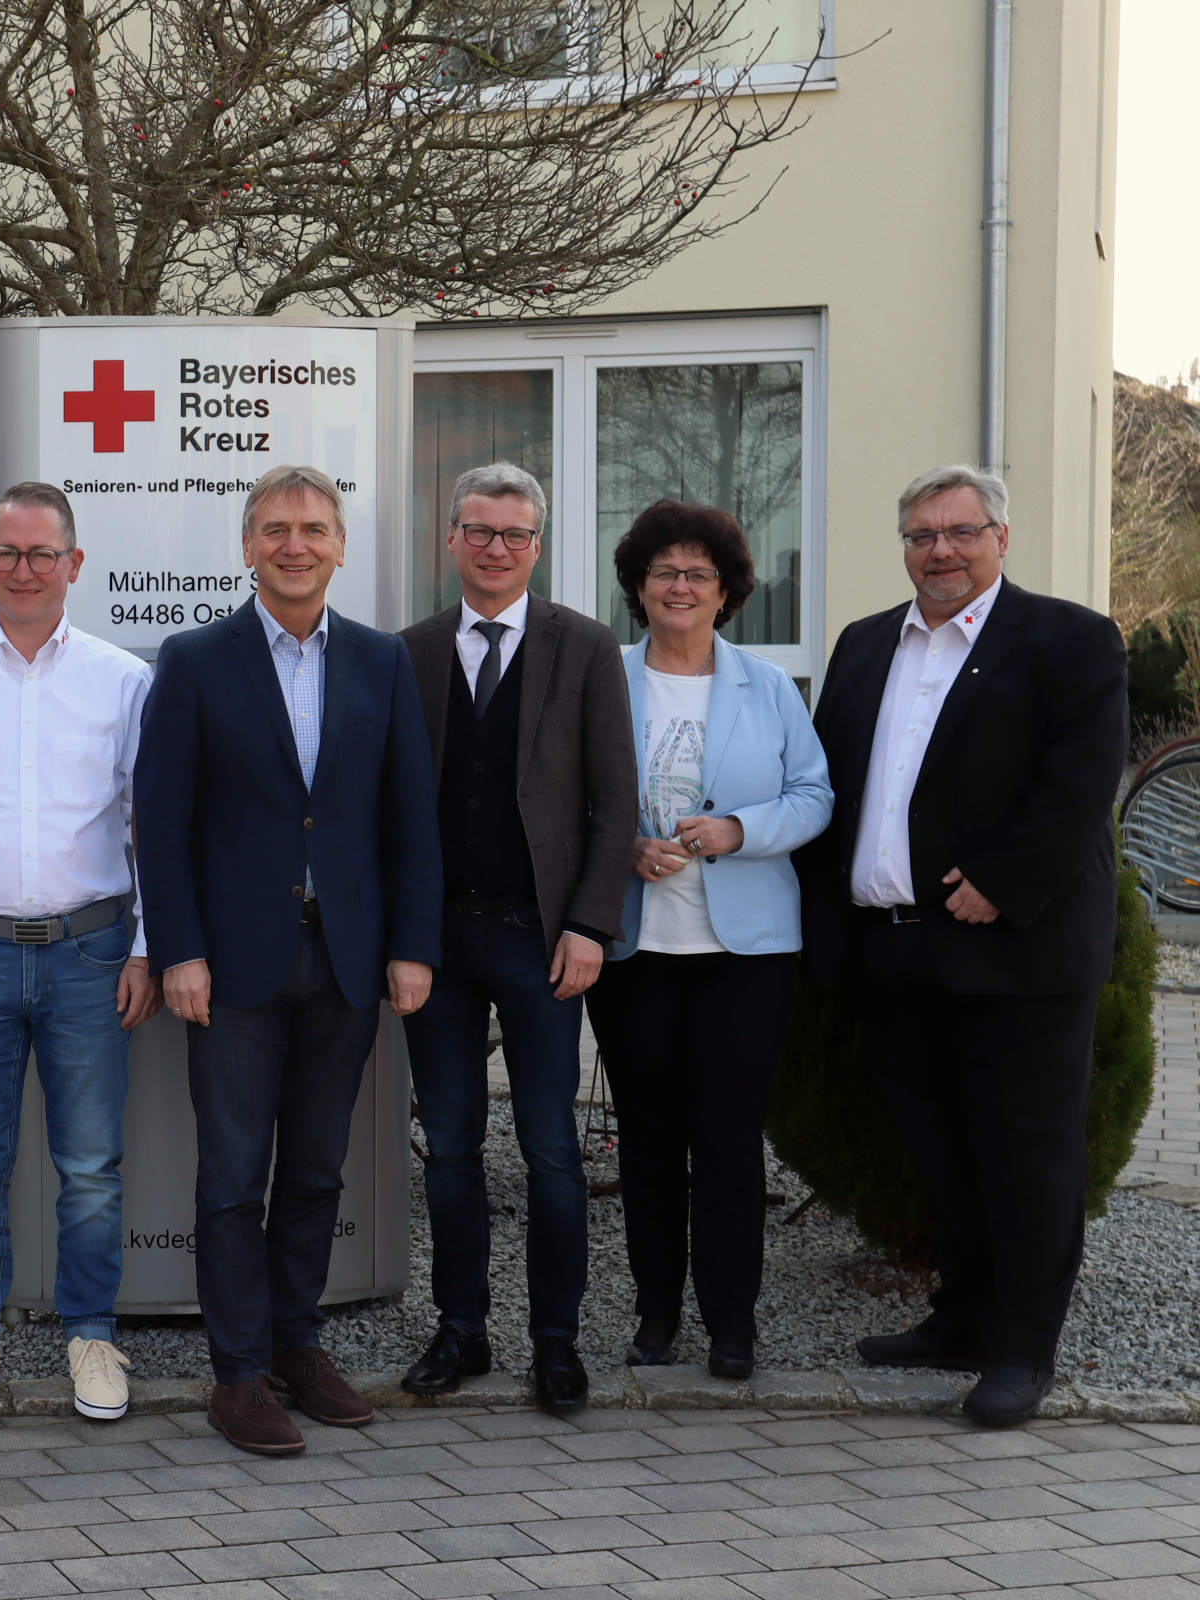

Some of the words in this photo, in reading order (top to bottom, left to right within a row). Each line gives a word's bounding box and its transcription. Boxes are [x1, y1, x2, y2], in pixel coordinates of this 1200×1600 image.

[180, 358, 356, 390] Bayerisches
[180, 393, 270, 418] Rotes
[180, 426, 270, 452] Kreuz
[62, 479, 143, 494] Senioren-
[147, 478, 179, 493] und
[184, 478, 259, 496] Pflegehe
[109, 571, 243, 592] Mühlhamer
[249, 570, 259, 591] S
[110, 603, 186, 625] 94486
[193, 603, 234, 624] Ost
